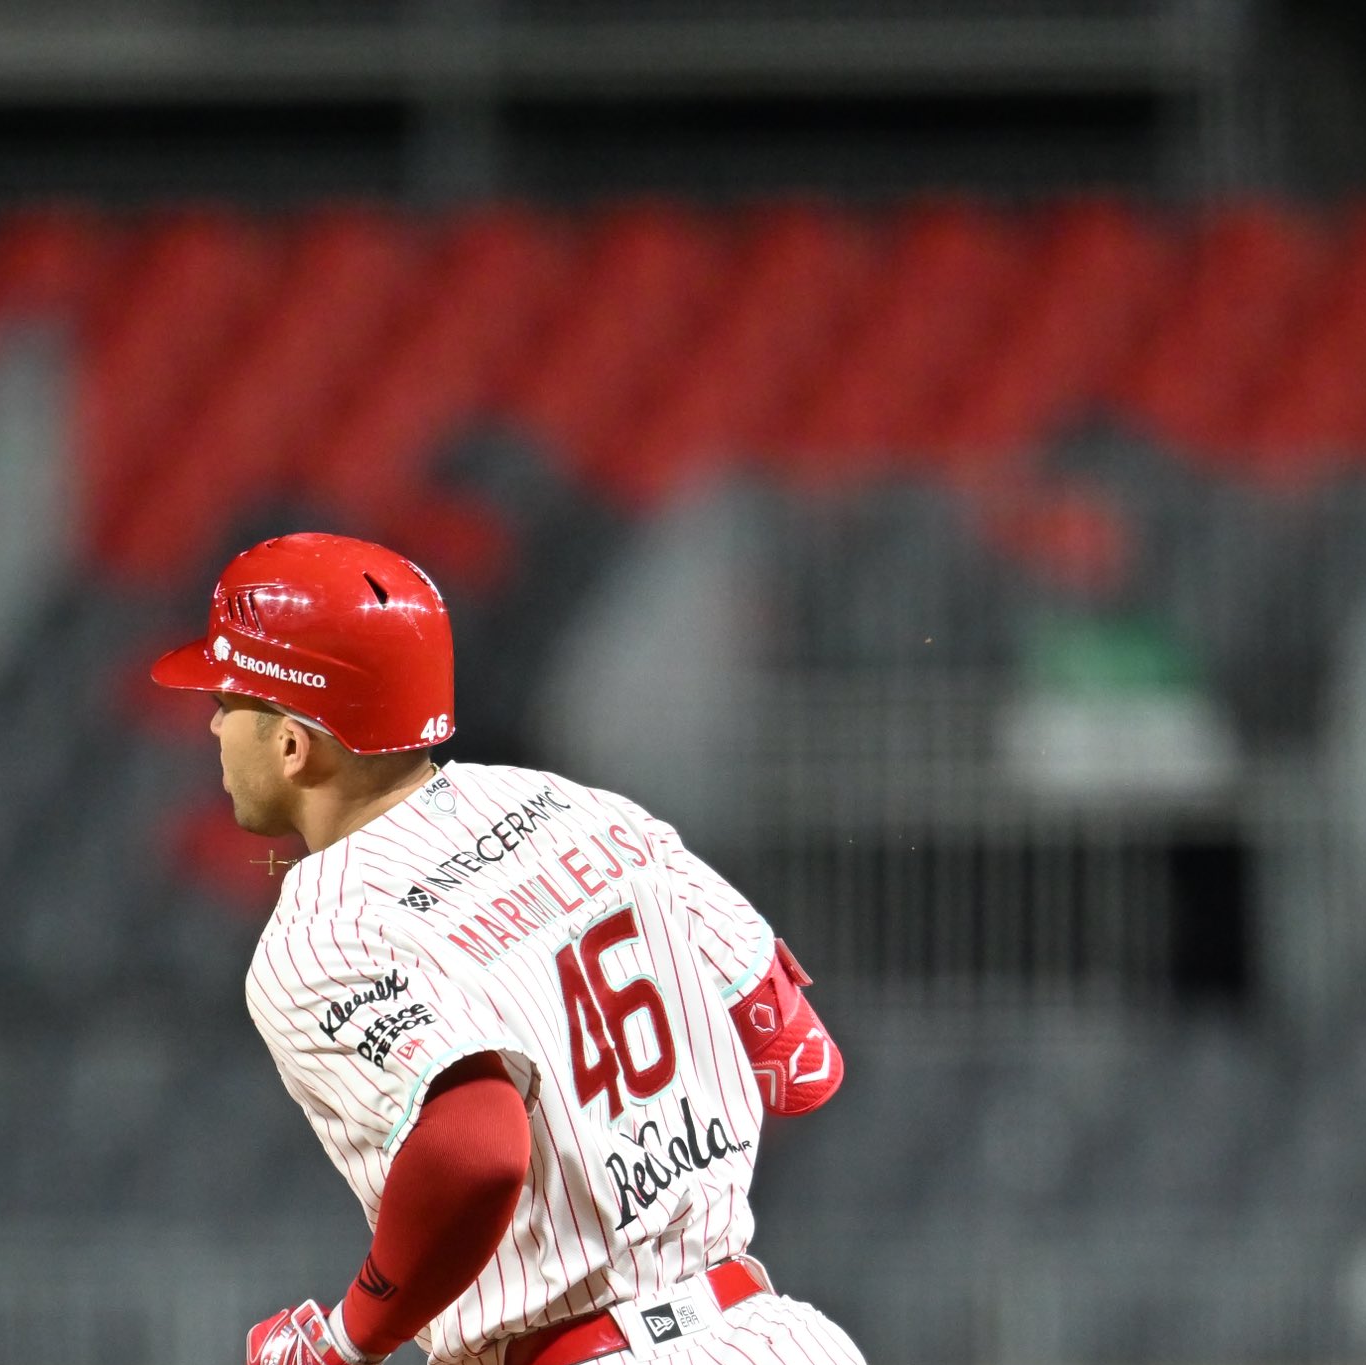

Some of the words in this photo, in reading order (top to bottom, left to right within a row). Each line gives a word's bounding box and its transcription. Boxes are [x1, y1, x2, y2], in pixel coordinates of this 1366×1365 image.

[421, 713, 448, 742] 46
[318, 968, 409, 1042] Kleenex
[357, 1003, 428, 1062] Office
[553, 902, 678, 1127] 46
[373, 1013, 436, 1072] DEPOT
[676, 1304, 695, 1318] NEW
[680, 1315, 700, 1328] ERA
